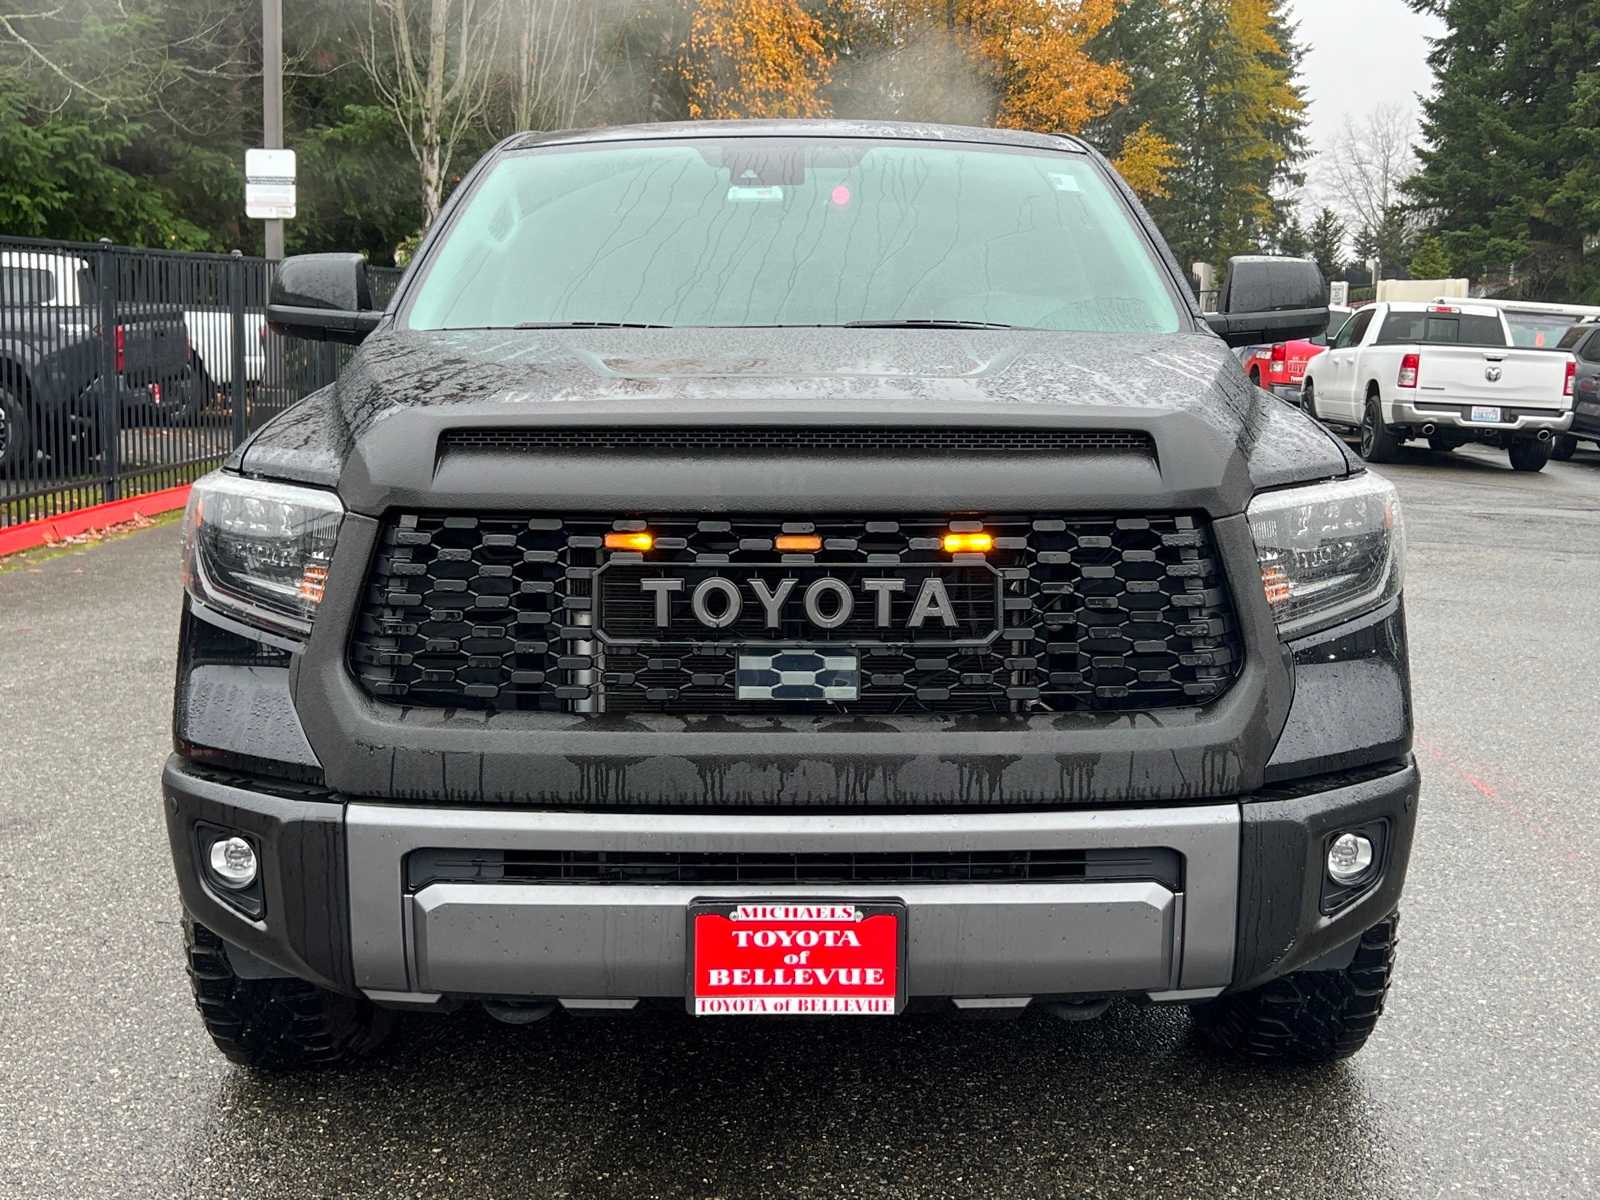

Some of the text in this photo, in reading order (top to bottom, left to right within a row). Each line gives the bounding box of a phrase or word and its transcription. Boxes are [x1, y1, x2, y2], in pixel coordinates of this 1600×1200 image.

[640, 577, 959, 629] TOYOTA
[741, 906, 853, 919] MICHAELS
[732, 930, 861, 948] TOYOTA
[783, 950, 811, 965] of
[708, 968, 885, 986] BELLEVUE
[698, 999, 893, 1012] TOYOTA of BELLEVUE
